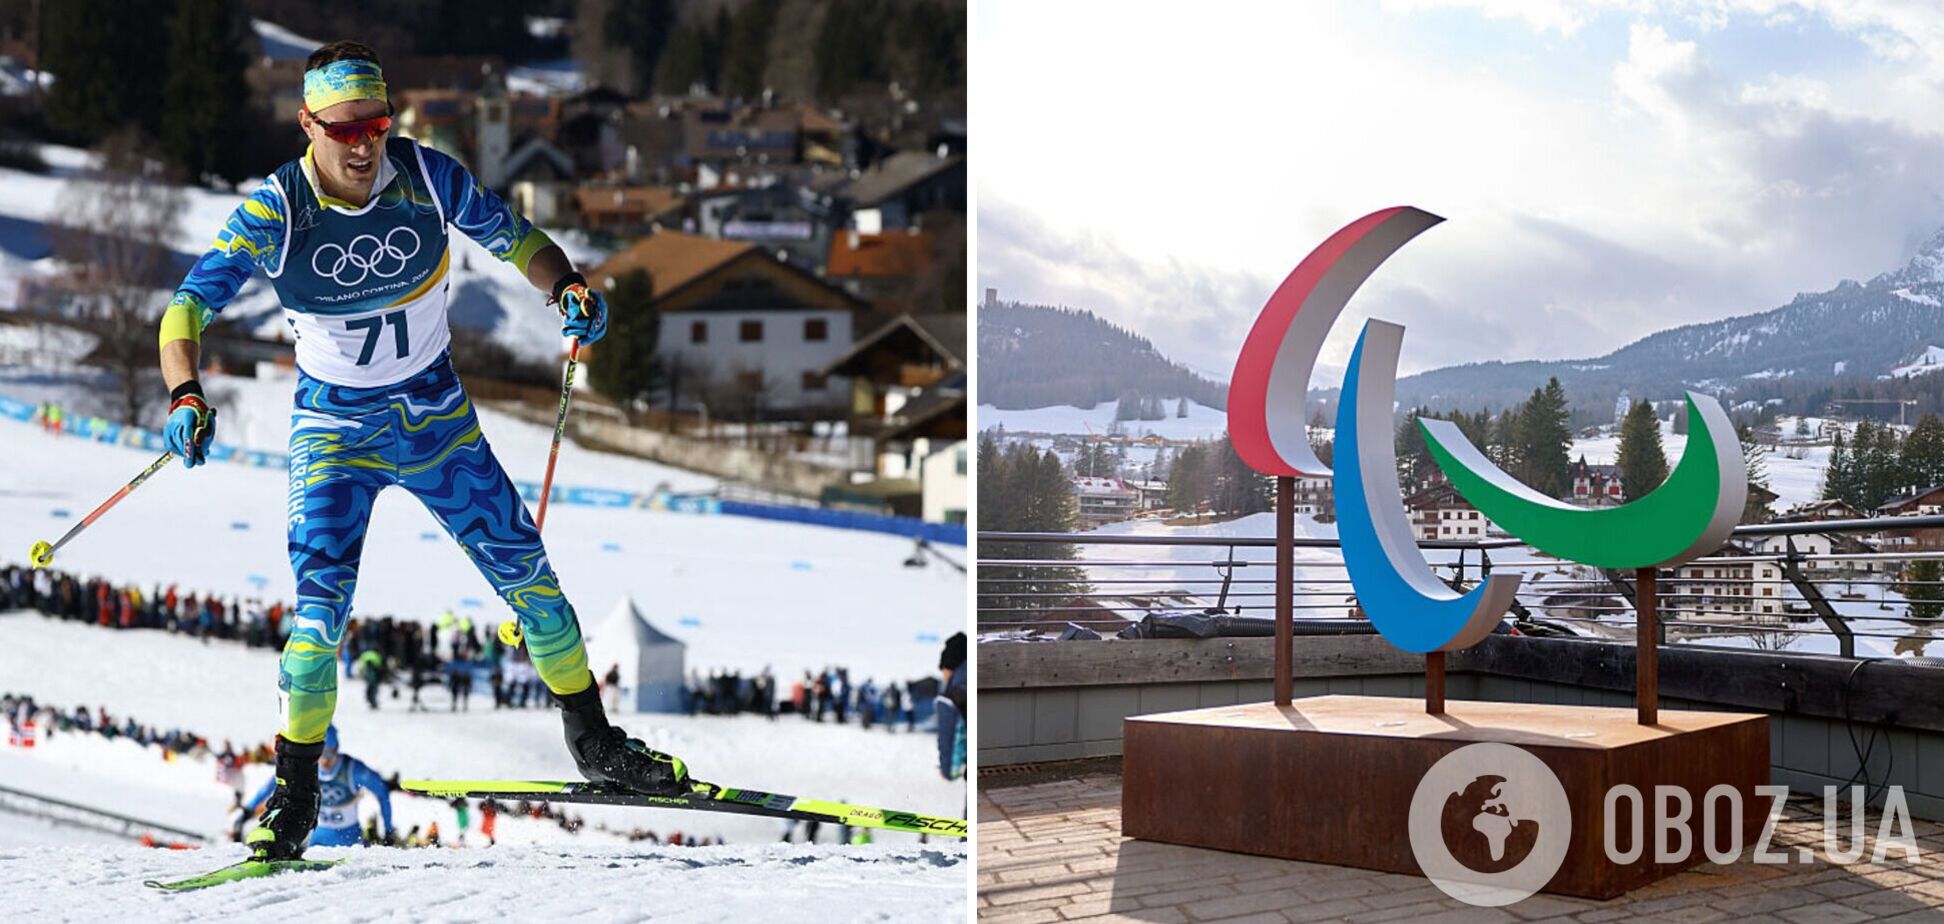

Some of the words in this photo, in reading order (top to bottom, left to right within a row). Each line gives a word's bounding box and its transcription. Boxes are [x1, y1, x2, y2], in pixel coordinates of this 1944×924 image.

[314, 290, 361, 303] MILANO
[362, 280, 409, 297] CORTINA
[345, 310, 409, 366] 71
[288, 439, 309, 532] UKRAINE
[648, 796, 689, 805] FISCHER
[884, 813, 967, 834] FISCH
